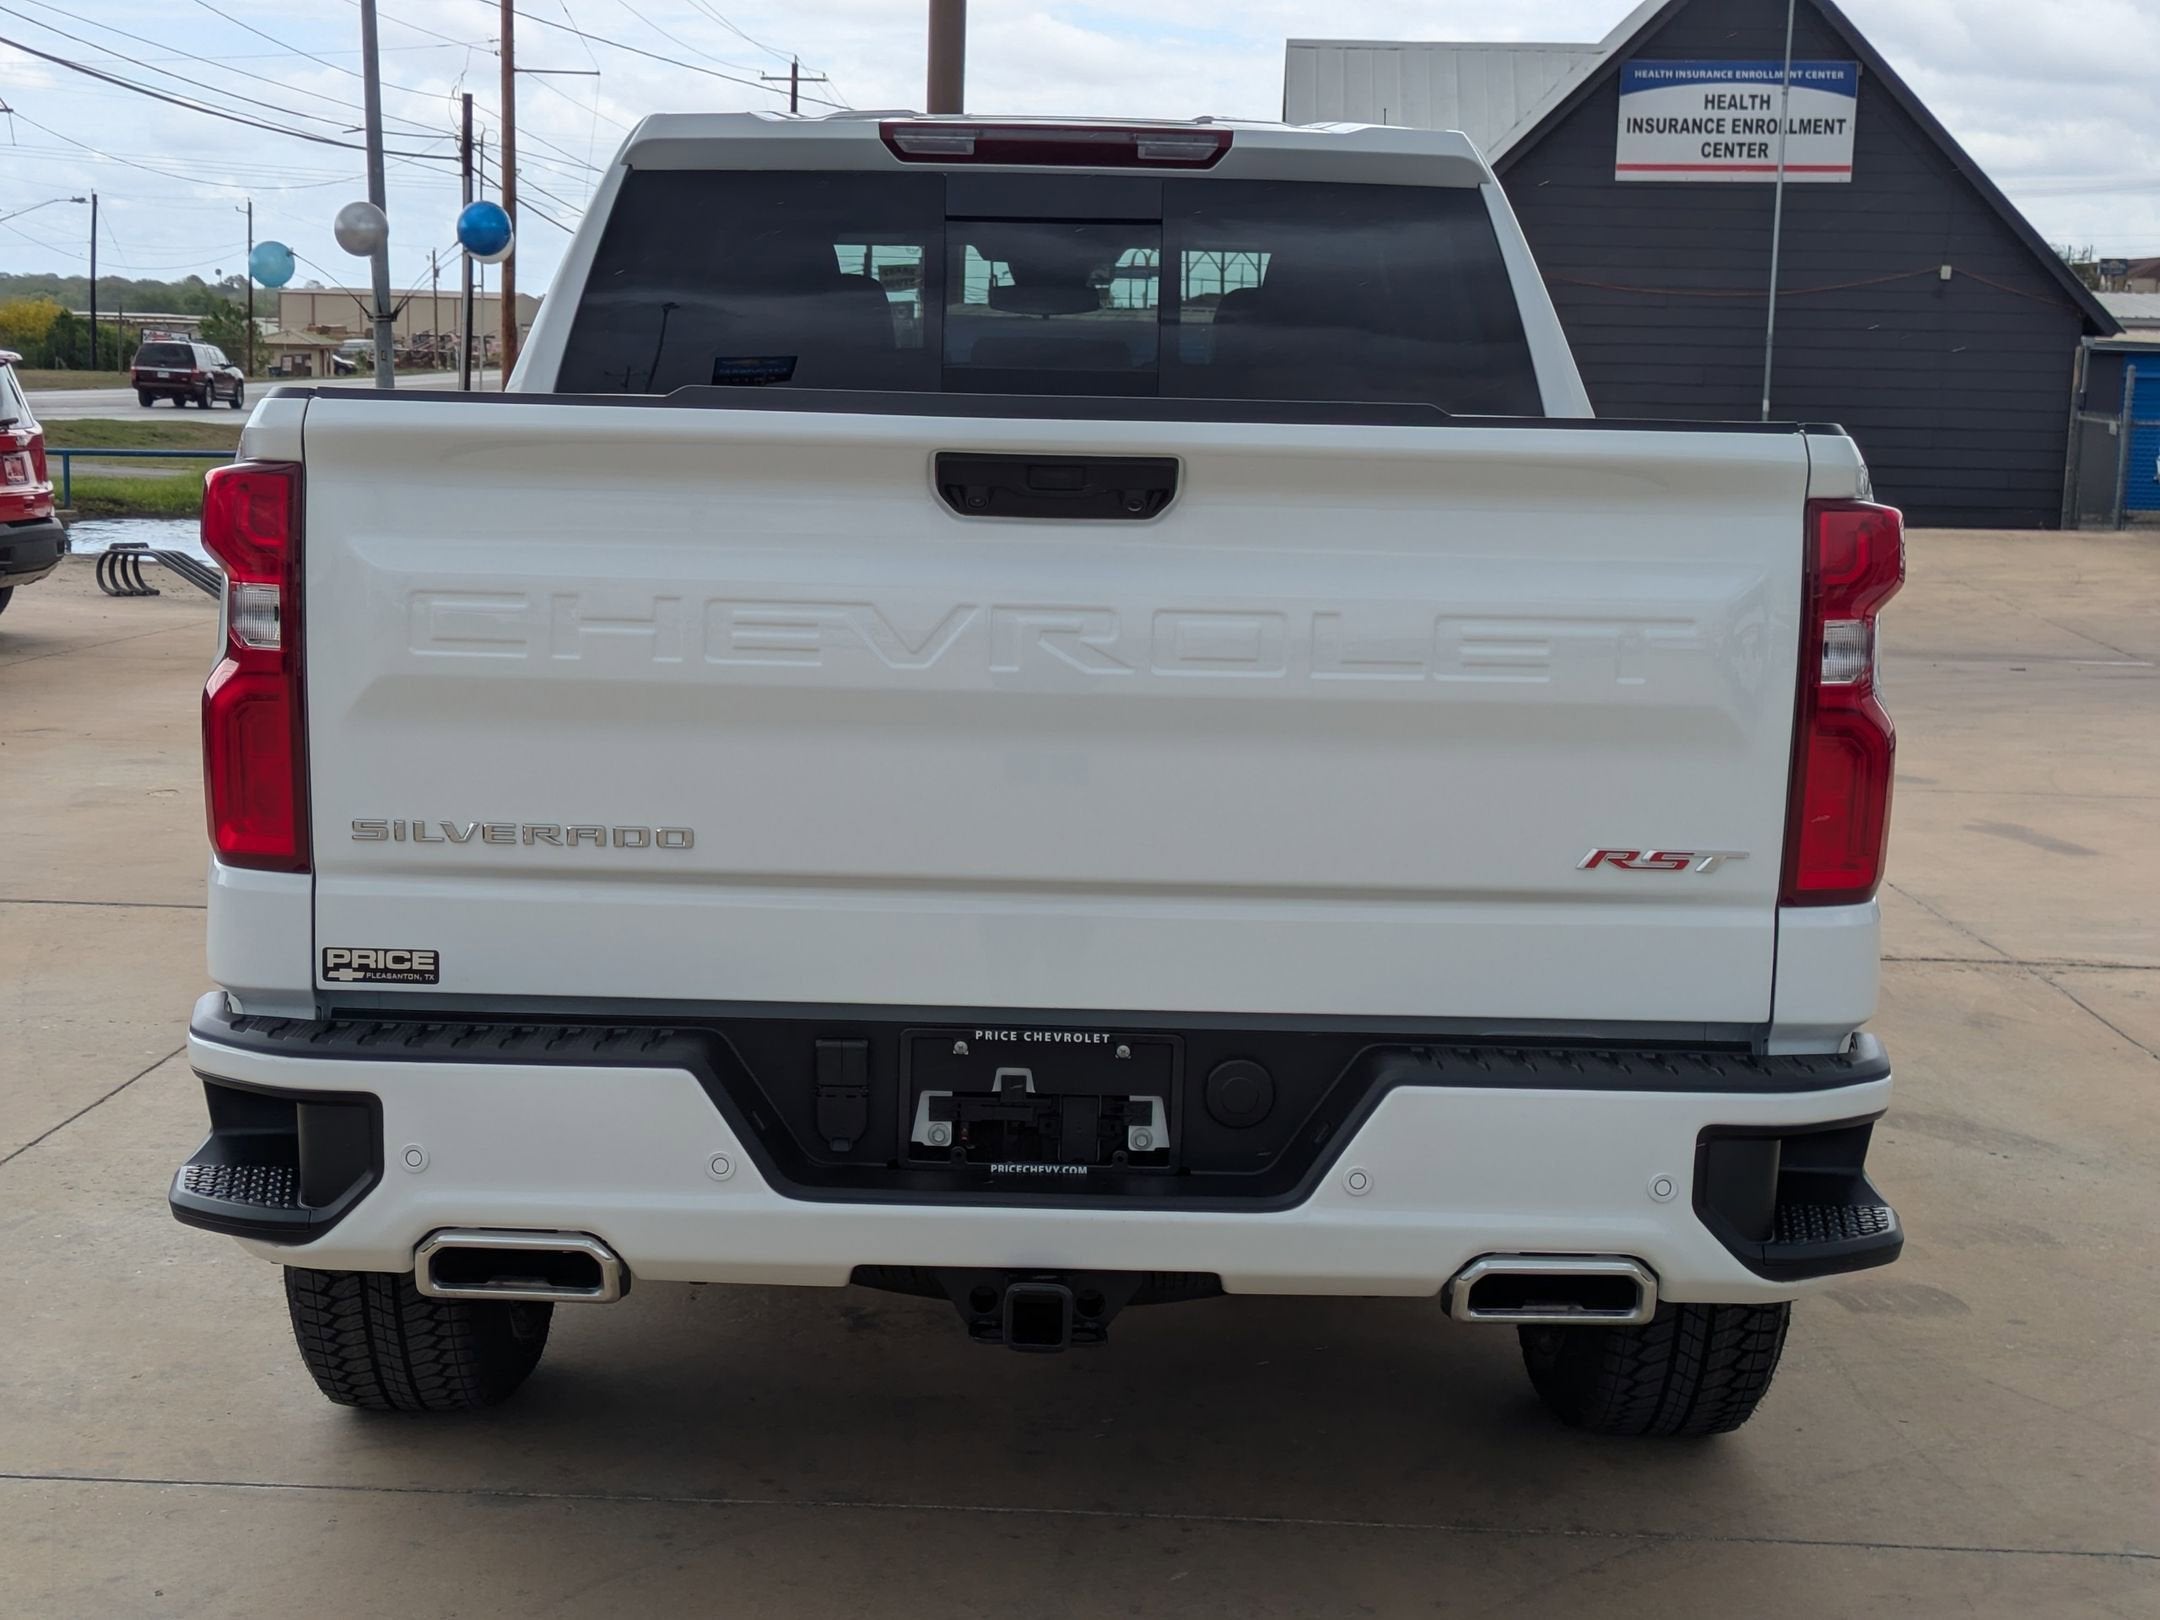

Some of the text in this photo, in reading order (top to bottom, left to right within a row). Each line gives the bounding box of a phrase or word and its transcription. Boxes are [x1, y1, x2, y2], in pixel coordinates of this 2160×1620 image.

[1634, 69, 1845, 80] HEALTH INSURANCE ENROLLMNT CENTER
[1703, 94, 1771, 111] HEALTH
[1626, 117, 1725, 135] INSURANCE
[1701, 142, 1769, 159] CENTER
[406, 590, 1698, 686] CHEVROLET
[351, 818, 695, 850] SILVERADO
[1576, 847, 1750, 873] RST
[326, 949, 435, 971] PRICE
[366, 971, 435, 981] PLEASANTON, TX
[975, 1030, 1110, 1043] PRICE CHEVROLET
[990, 1164, 1088, 1175] PRICECHEVY.COM
